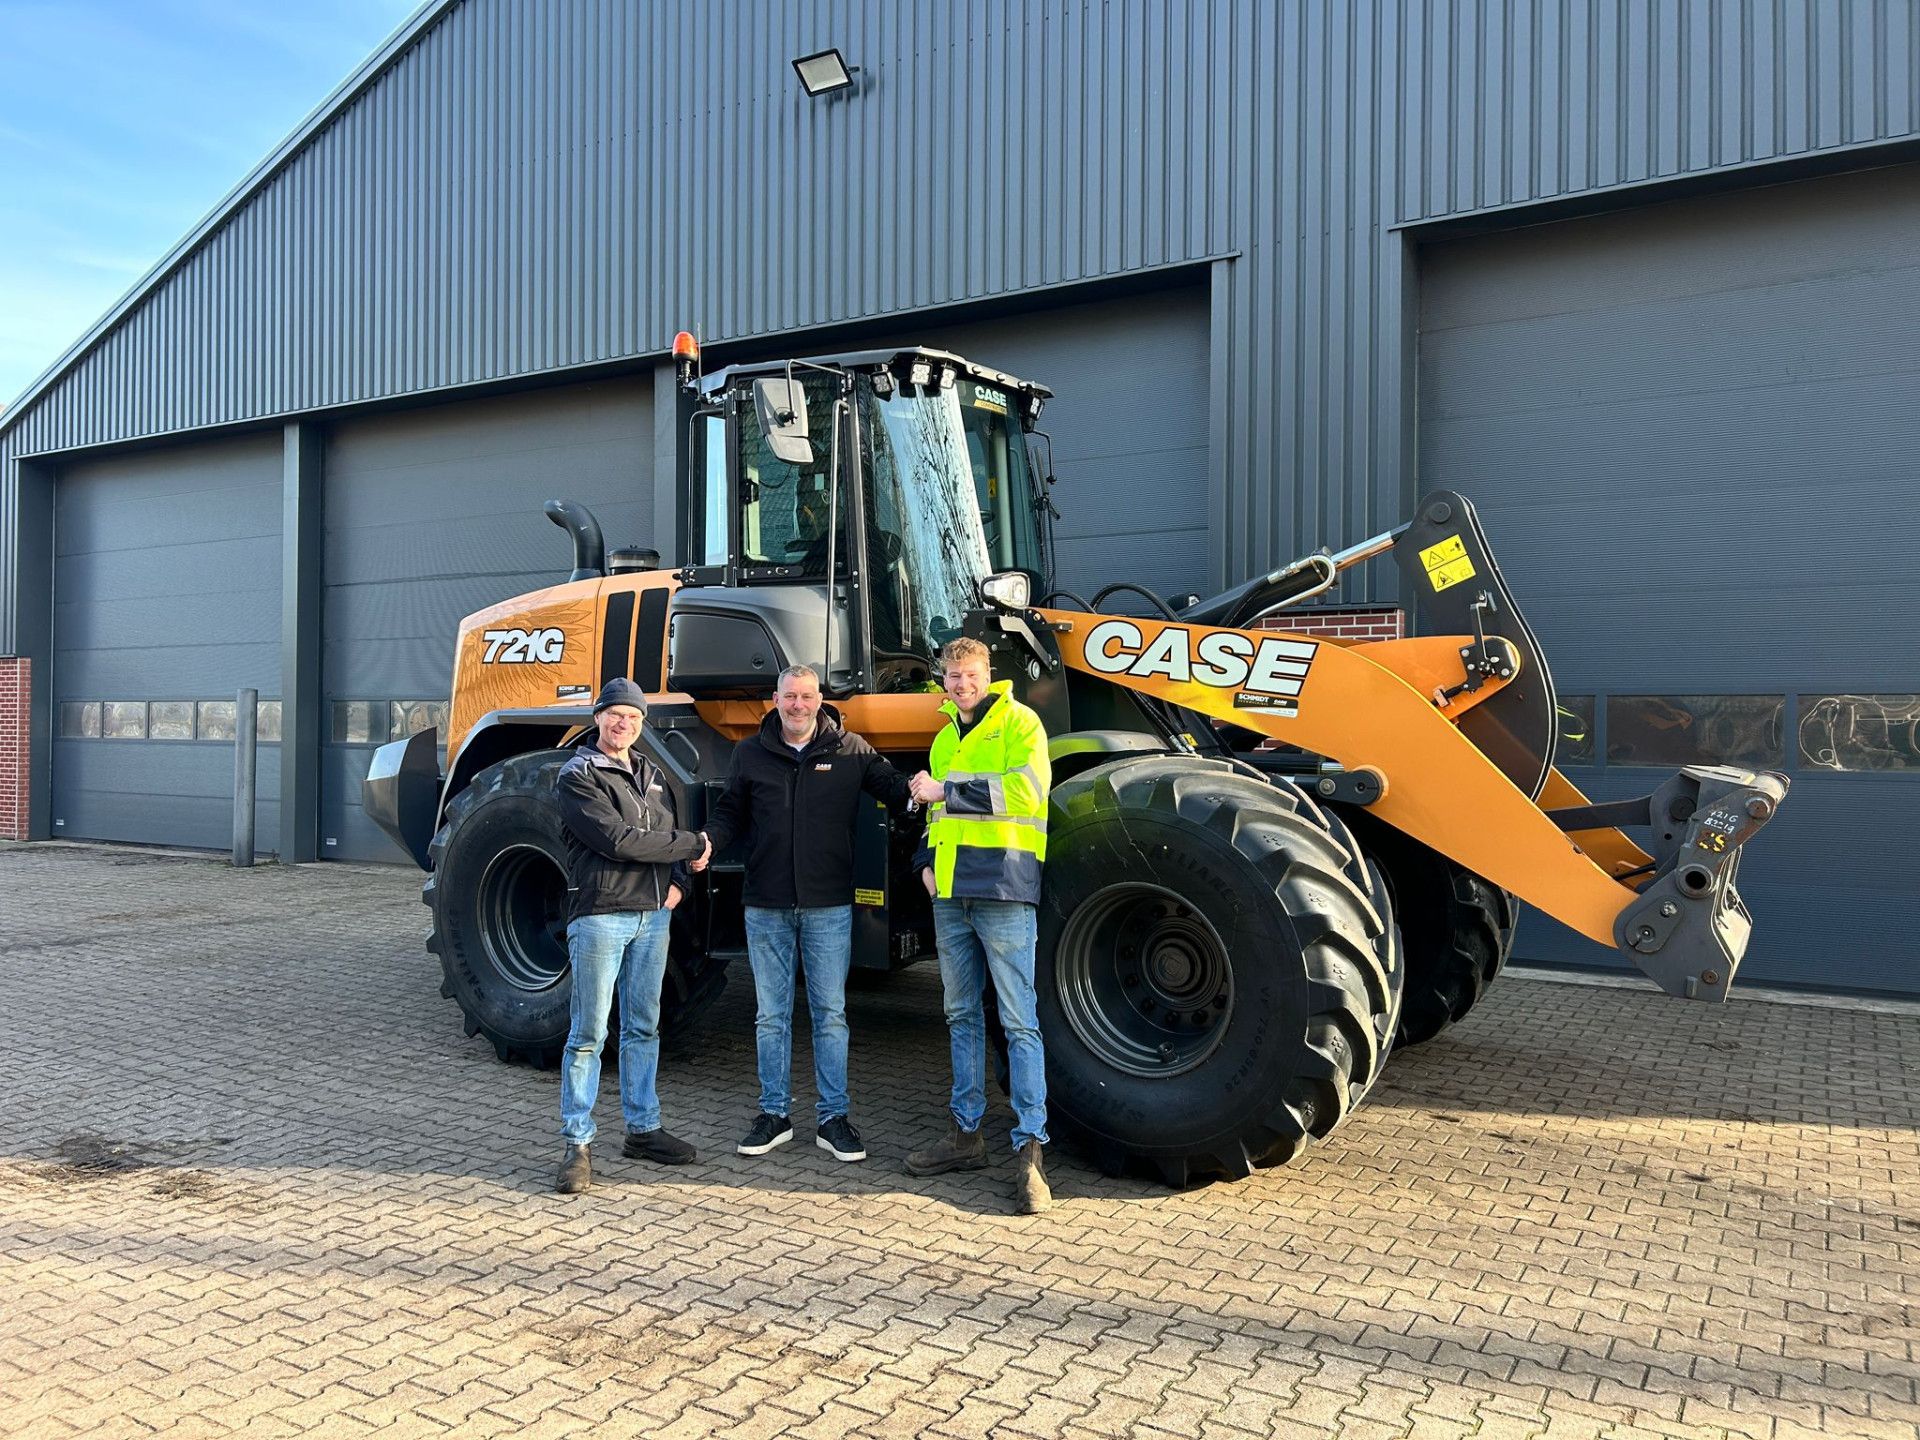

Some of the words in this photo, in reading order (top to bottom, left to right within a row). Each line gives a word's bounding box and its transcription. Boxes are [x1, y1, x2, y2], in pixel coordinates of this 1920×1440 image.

[974, 385, 1006, 406] CASE
[482, 627, 565, 663] 721G
[1083, 620, 1320, 696] CASE
[1238, 693, 1270, 703] SCHMIDT
